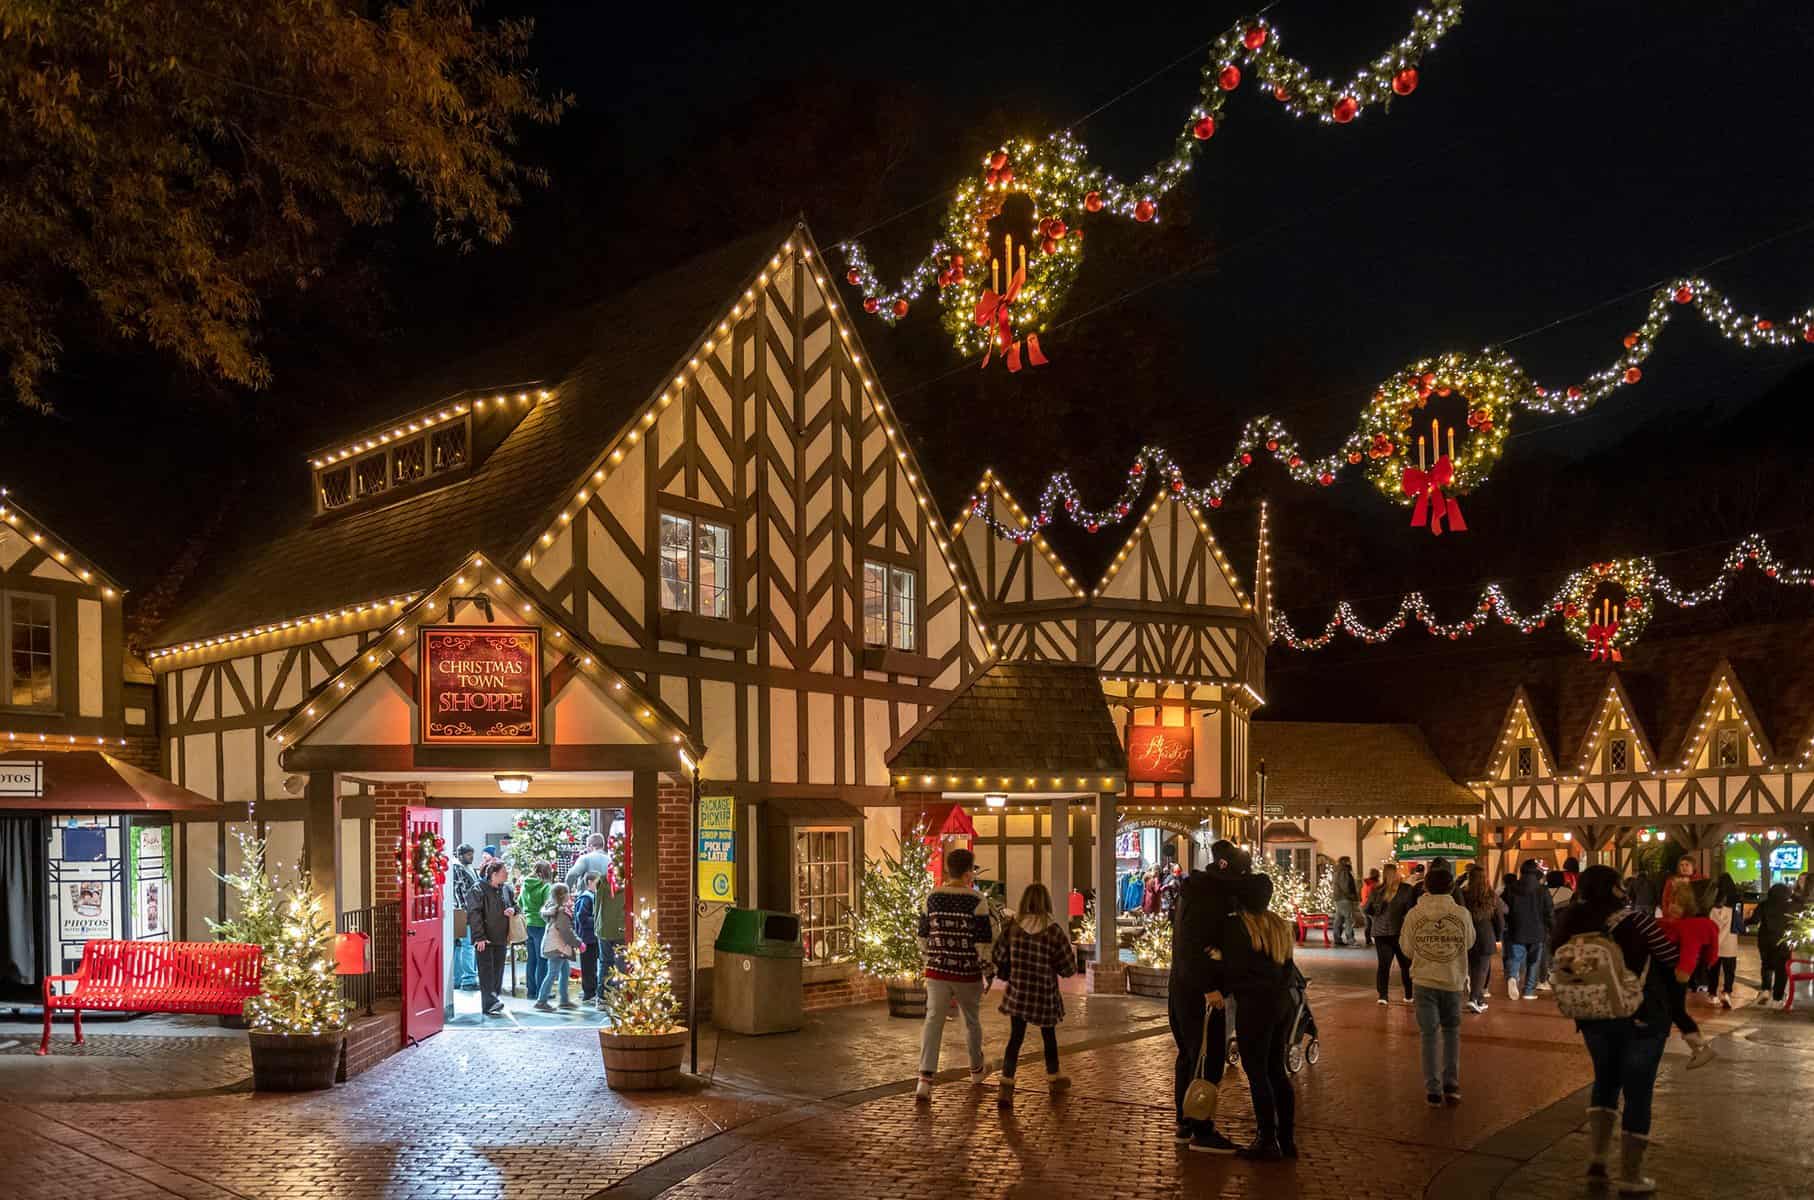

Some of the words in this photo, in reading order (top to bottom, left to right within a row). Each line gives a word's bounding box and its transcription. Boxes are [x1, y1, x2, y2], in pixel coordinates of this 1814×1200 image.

[439, 660, 523, 674] CHRISTMAS
[457, 674, 505, 688] TOWN
[438, 691, 524, 712] SHOPPE
[701, 799, 730, 811] PACKAGE
[701, 811, 731, 827] PICKUP
[704, 841, 721, 852] PICK
[722, 841, 731, 851] UP
[707, 852, 728, 861] LATER
[64, 919, 109, 927] PHOTOS
[1415, 935, 1440, 943] OUTER
